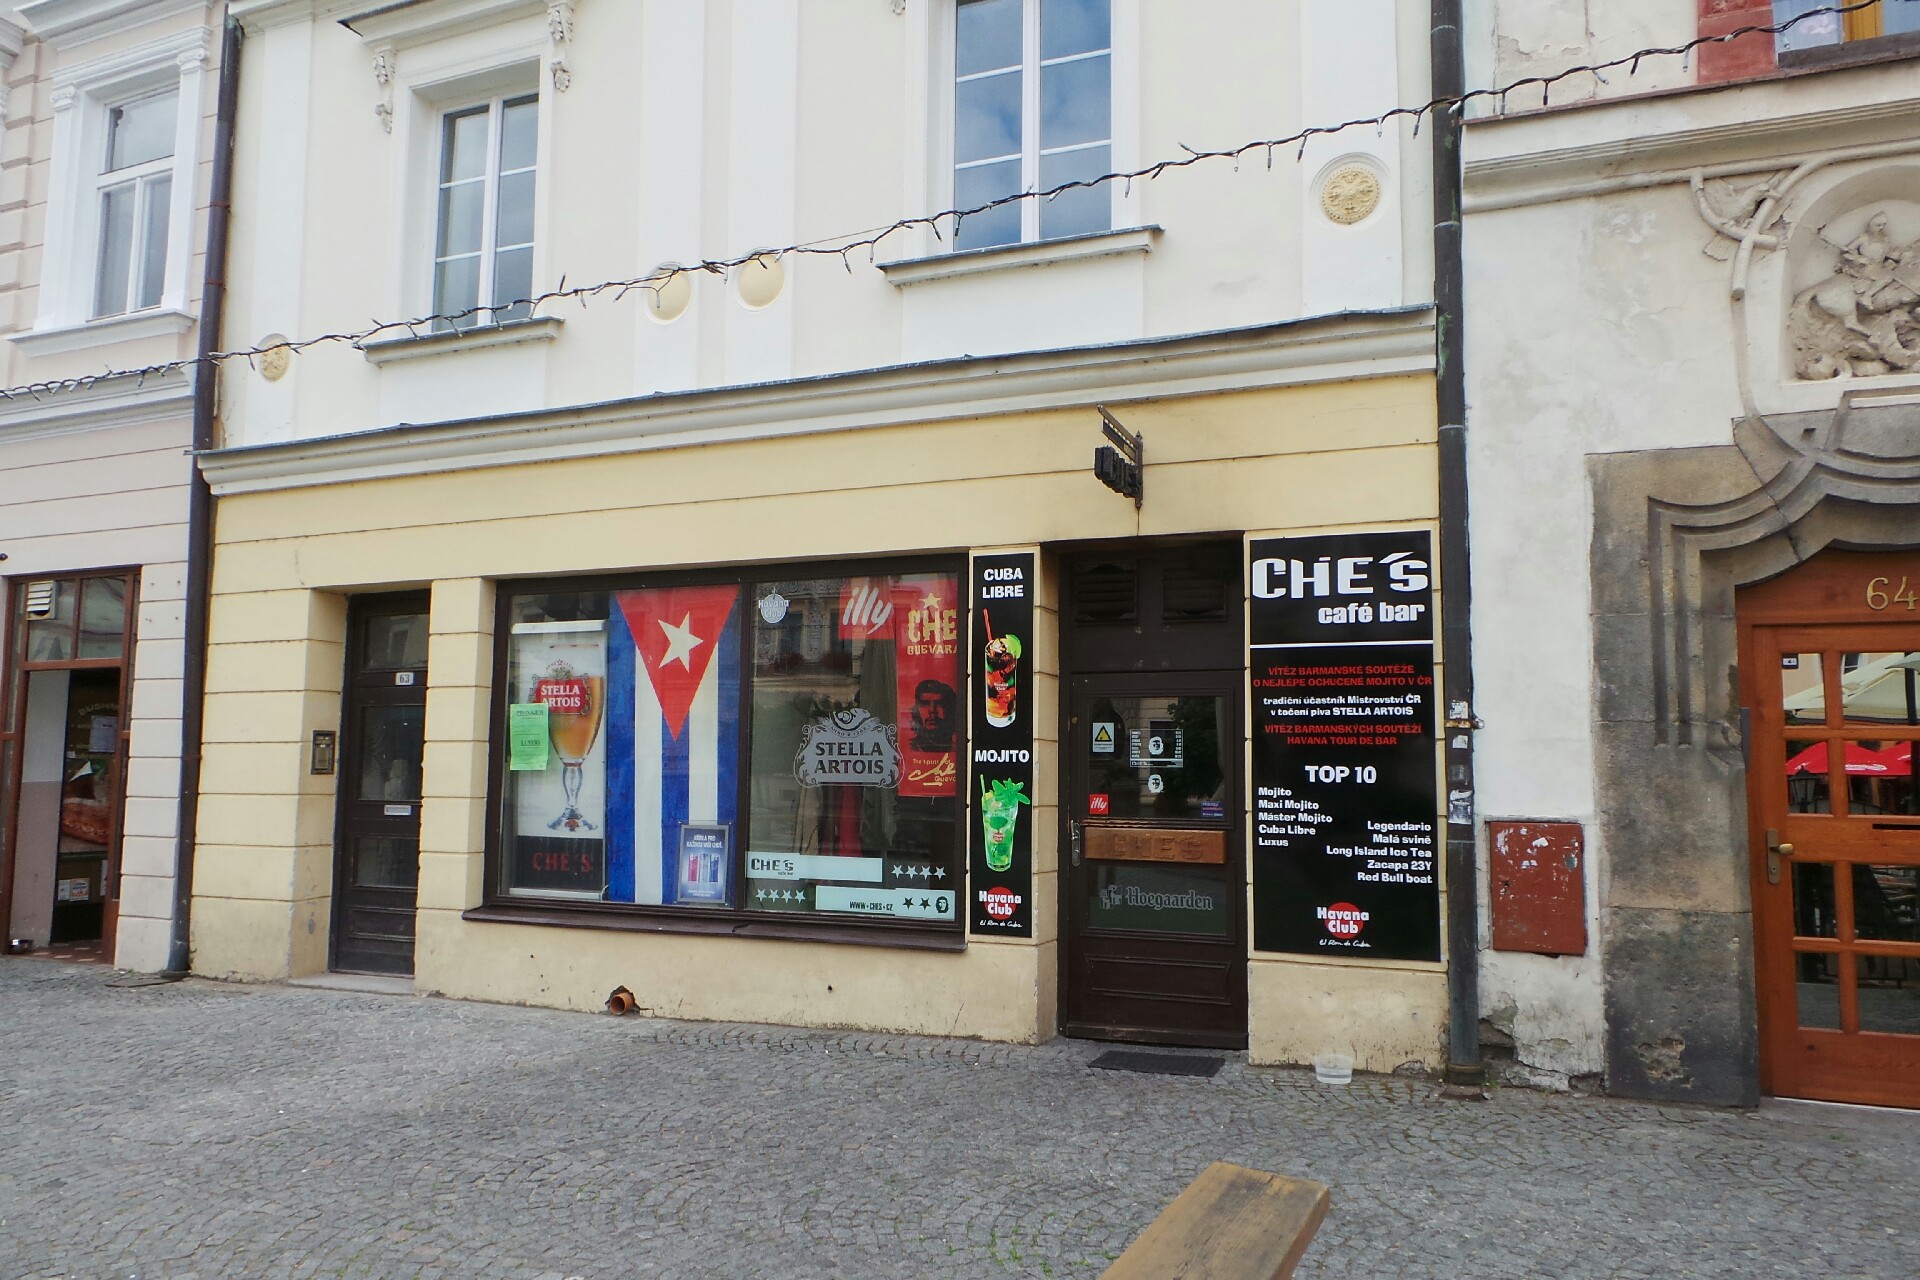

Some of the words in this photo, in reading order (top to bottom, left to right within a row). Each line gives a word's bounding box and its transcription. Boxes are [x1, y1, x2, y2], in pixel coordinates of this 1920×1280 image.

[984, 568, 1023, 581] CUBA
[982, 585, 1024, 599] LIBRE
[1866, 576, 1919, 610] 64
[758, 599, 789, 610] Havana
[842, 585, 892, 635] illy
[764, 609, 782, 618] Club
[1318, 602, 1373, 624] café
[1380, 602, 1426, 623] bar
[908, 608, 957, 642] CHE
[399, 674, 410, 684] 63
[1253, 679, 1260, 687] O
[1366, 678, 1405, 686] MOJITO
[1417, 676, 1432, 685] ČR
[541, 684, 580, 696] STELLA
[1263, 697, 1302, 705] tradiční
[1304, 696, 1346, 704] účastník
[1348, 696, 1404, 704] Mistrovství
[1406, 694, 1421, 704] ČR
[1278, 708, 1309, 716] točení
[1310, 709, 1330, 718] piva
[1332, 707, 1372, 716] STELLA
[1374, 707, 1414, 716] ARTOIS
[1294, 724, 1373, 734] BARMANSKÝCH
[815, 742, 884, 756] STELLA
[975, 750, 1030, 763] MOJITO
[814, 759, 884, 774] ARTOIS
[1304, 765, 1350, 784] TOP
[1354, 766, 1377, 784] 10
[1258, 787, 1292, 798] Mojito
[1090, 797, 1108, 811] illy
[1258, 800, 1282, 810] Maxi
[1284, 800, 1320, 812] Mojito
[1258, 812, 1296, 822] Máster
[1298, 813, 1333, 824] Mojito
[1258, 825, 1286, 834] Cuba
[1288, 826, 1316, 836] Libre
[1368, 821, 1432, 833] Legendario
[1258, 838, 1289, 847] Luxus
[1372, 834, 1400, 844] Malá
[1402, 834, 1432, 844] svině
[1326, 846, 1352, 857] Long
[1355, 846, 1388, 856] Island
[1390, 848, 1408, 857] Ice
[1410, 848, 1432, 858] Tea
[1367, 860, 1409, 870] Zacapa
[1410, 861, 1432, 870] 23Y
[1358, 872, 1380, 882] Red
[1382, 873, 1404, 882] Bull
[1406, 874, 1433, 884] boat
[978, 890, 1022, 904] Havana
[1126, 886, 1214, 910] Hoegaarden
[988, 903, 1012, 915] Club
[1317, 906, 1370, 921] Havana
[1328, 920, 1358, 934] Club
[1319, 938, 1328, 946] El
[1352, 940, 1372, 948] Cuba
